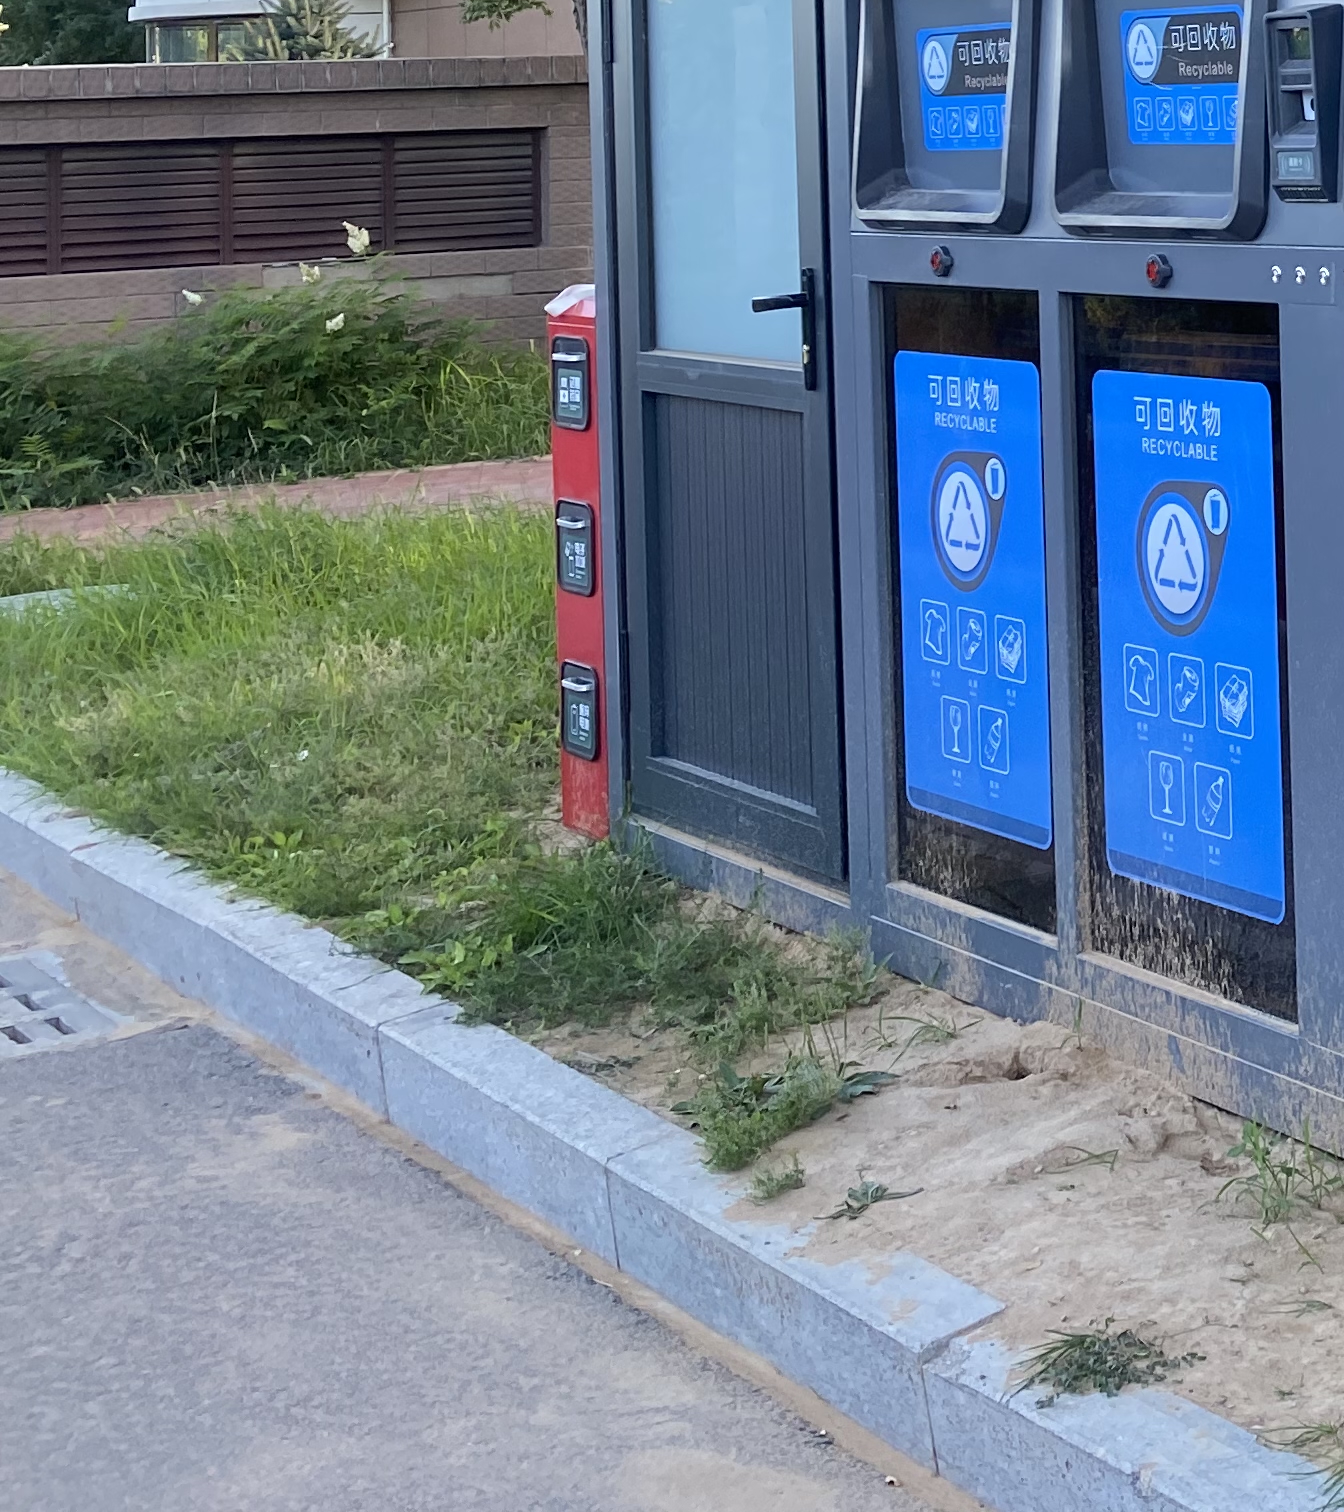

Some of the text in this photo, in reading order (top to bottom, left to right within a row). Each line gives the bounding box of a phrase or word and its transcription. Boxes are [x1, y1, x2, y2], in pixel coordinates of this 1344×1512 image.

[1168, 21, 1236, 52] 可回收物
[956, 37, 1010, 66] 可回收物
[1178, 60, 1234, 80] Recyclable
[927, 374, 1000, 412] 可回收物
[934, 411, 998, 434] RECYCLABLE
[1133, 396, 1221, 438] 可回收物
[1141, 437, 1219, 462] RECYCLABLE
